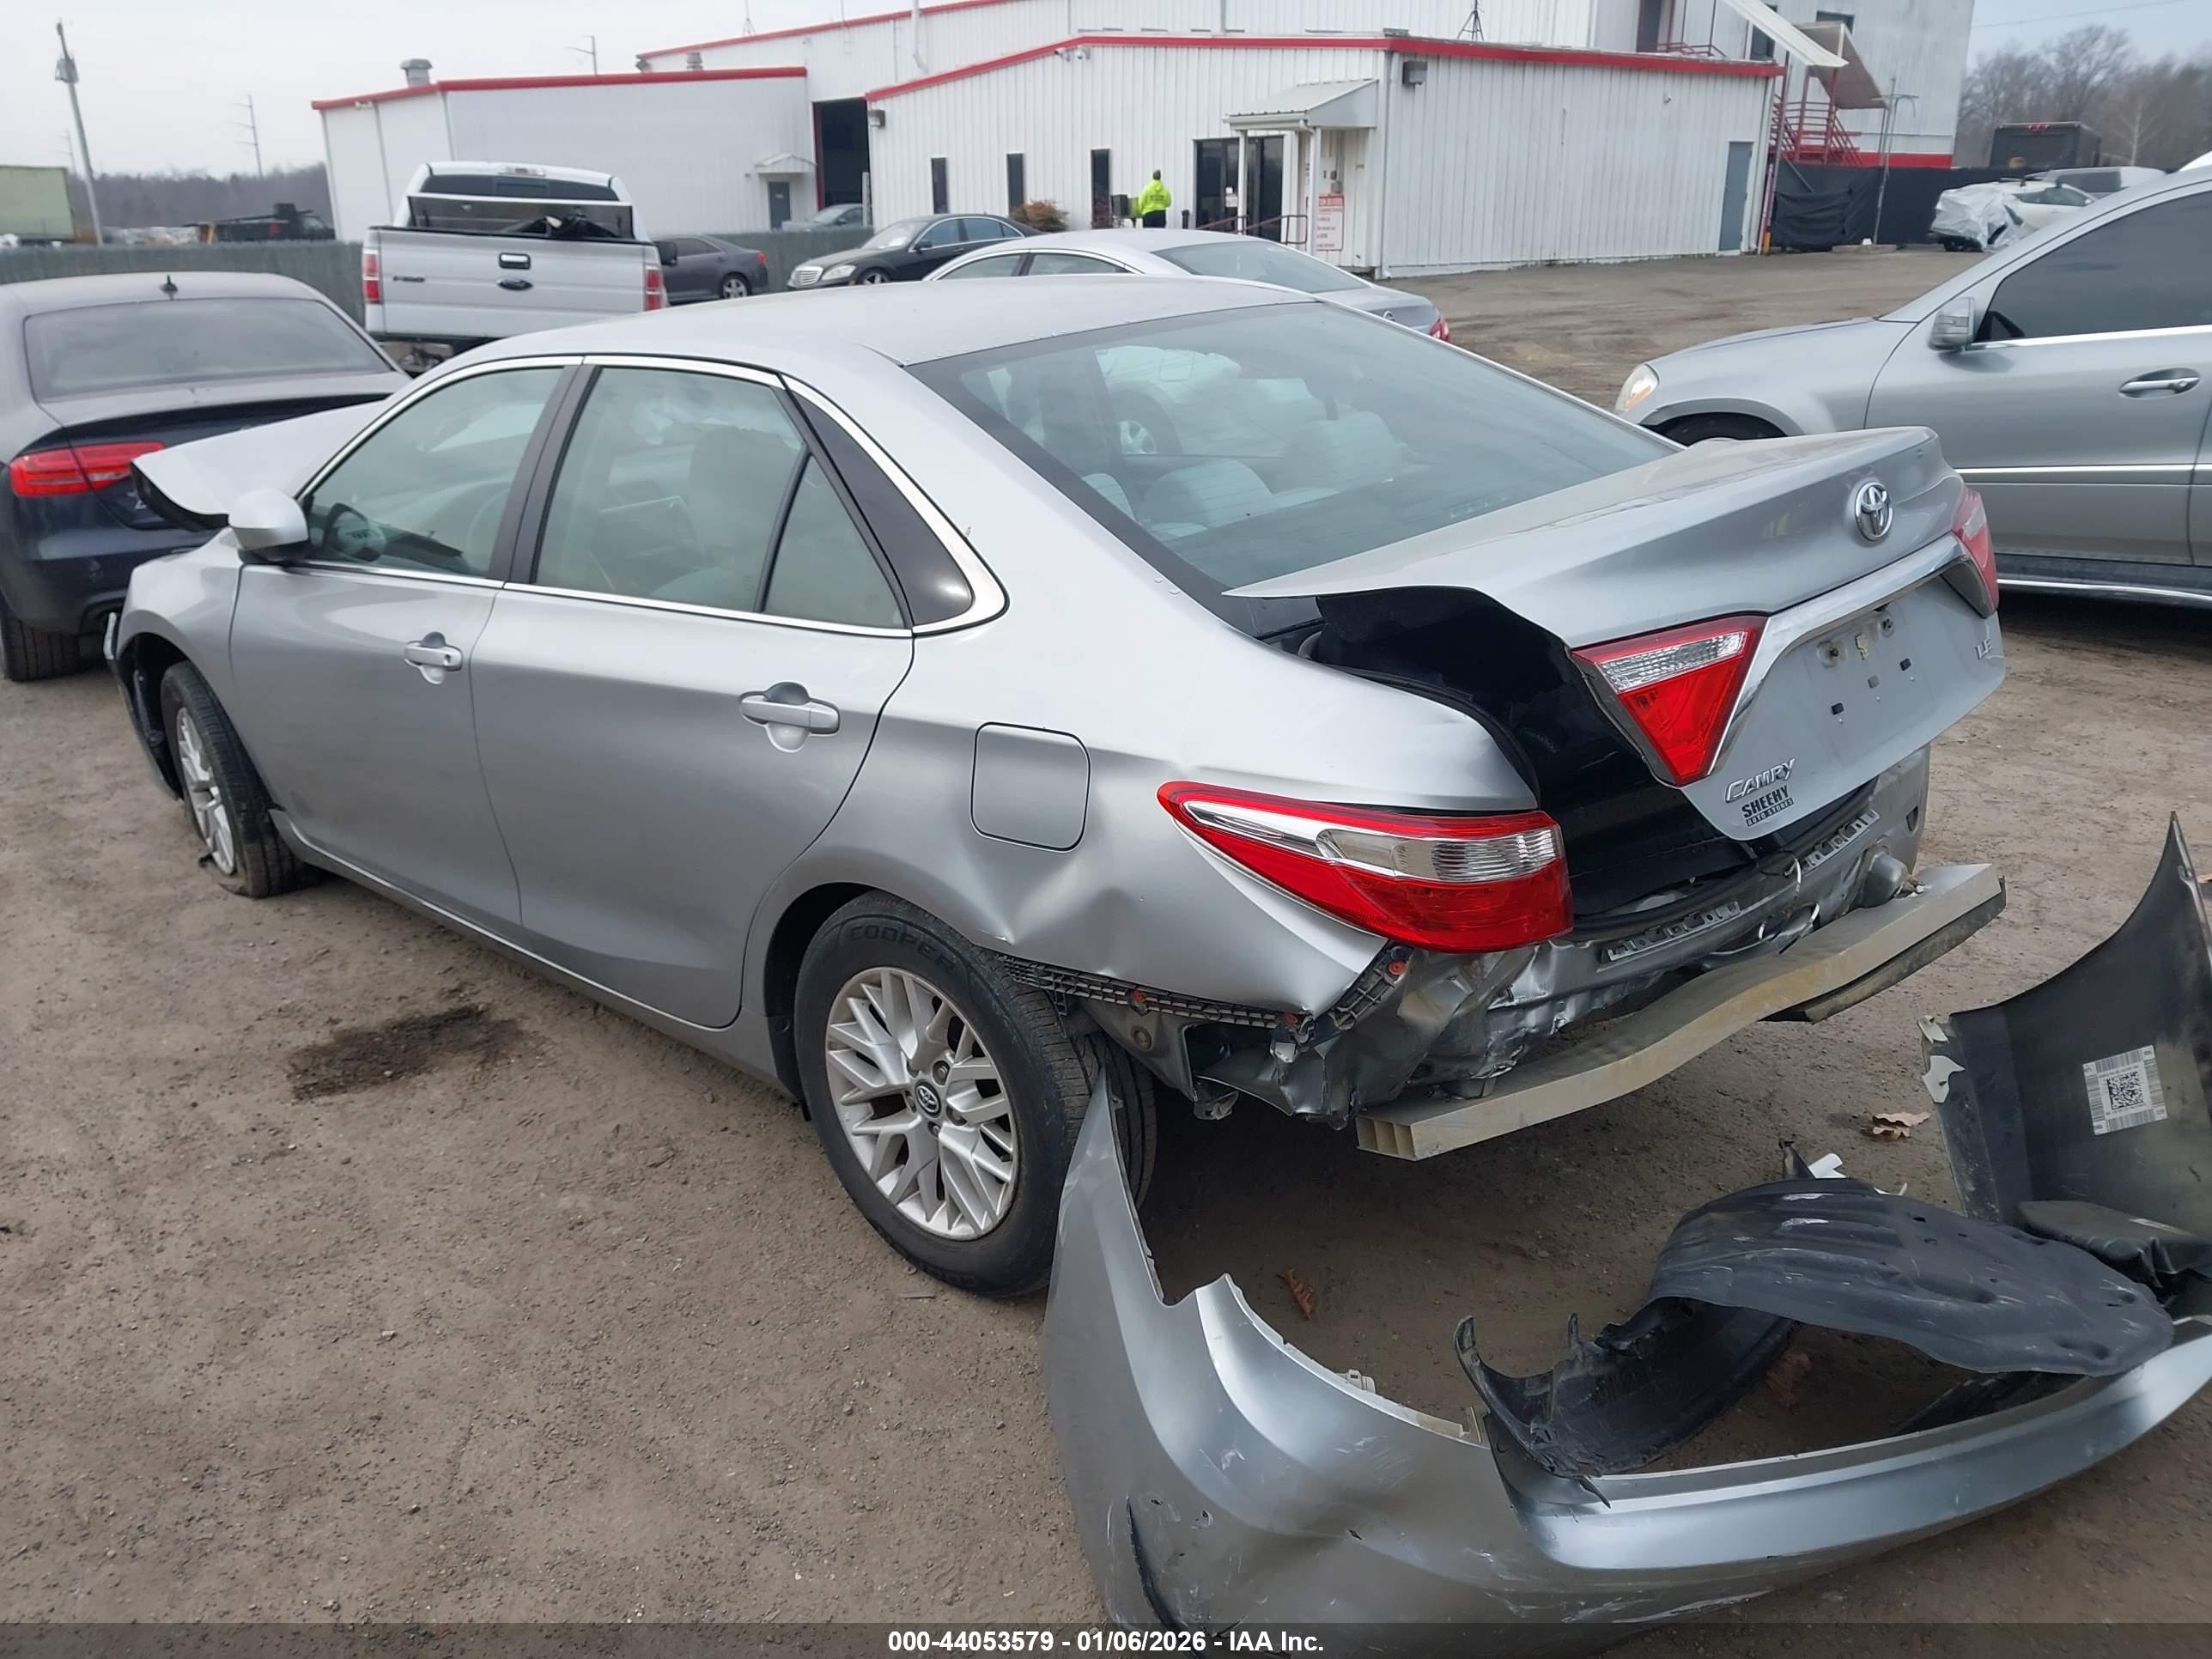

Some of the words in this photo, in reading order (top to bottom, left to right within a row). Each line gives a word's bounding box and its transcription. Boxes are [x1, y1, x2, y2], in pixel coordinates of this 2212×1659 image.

[1975, 638, 1993, 659] LE
[1726, 757, 1796, 803] CAMRY
[1741, 785, 1789, 817] SHEEHY
[1747, 812, 1766, 826] AUTO
[1767, 798, 1794, 816] STORES
[849, 923, 956, 973] COOPER
